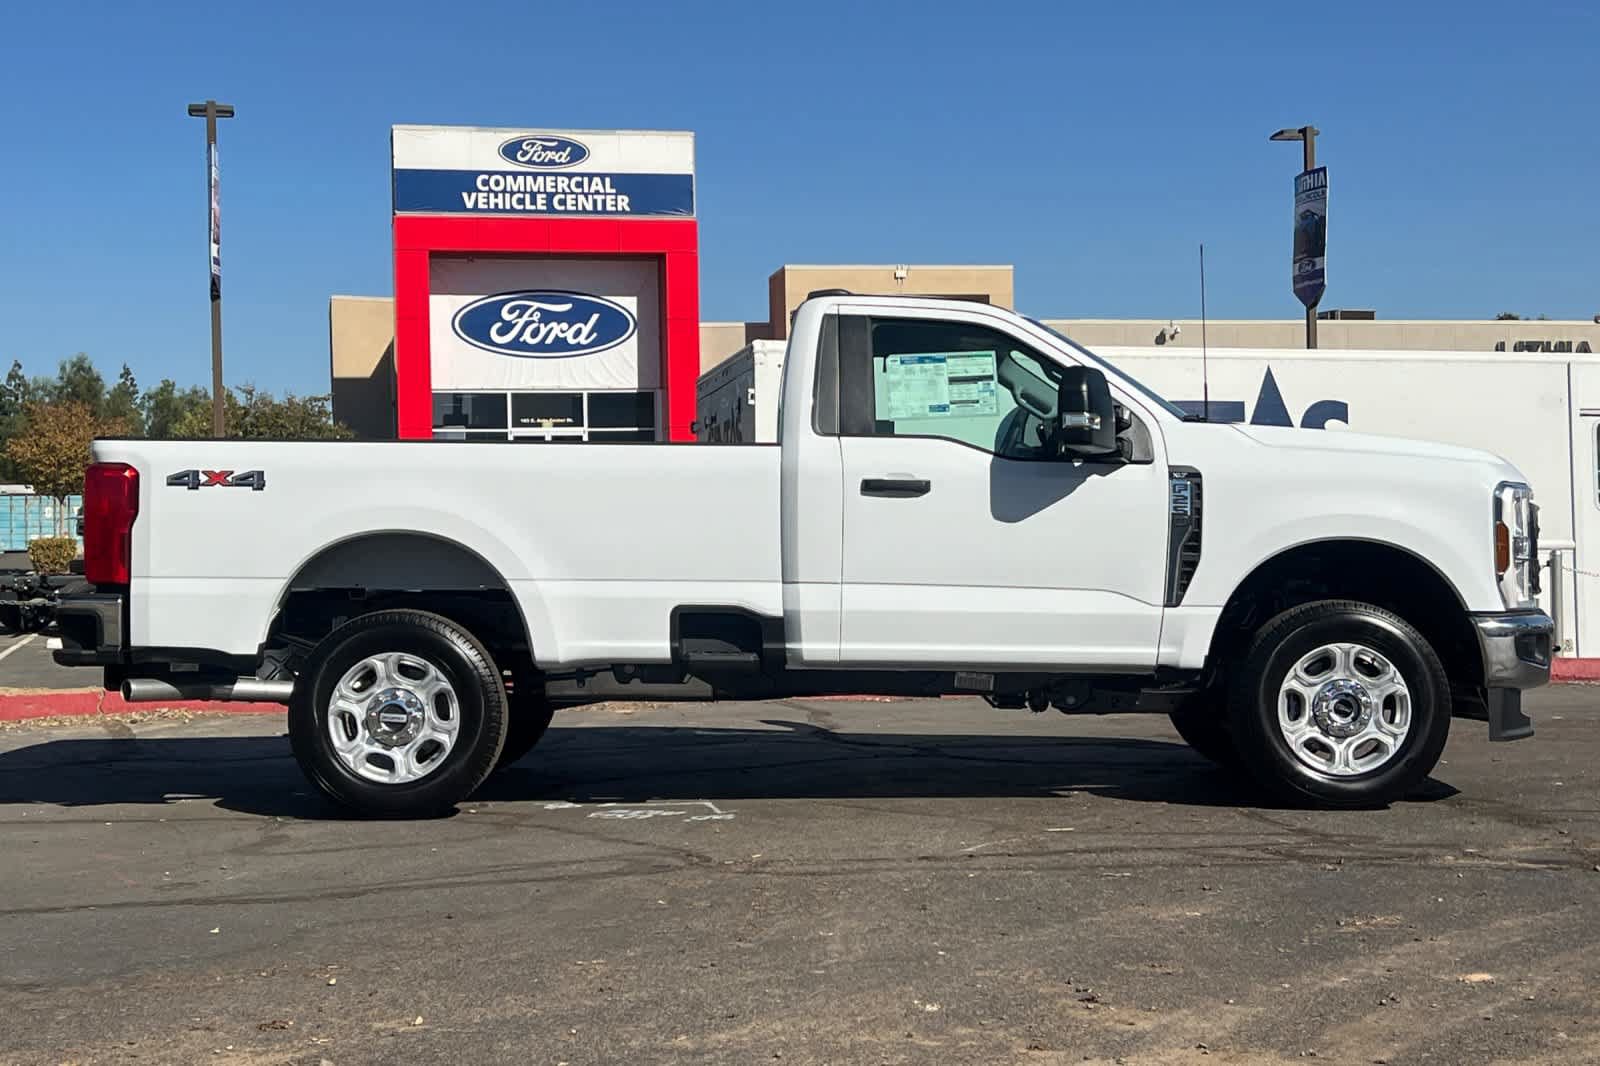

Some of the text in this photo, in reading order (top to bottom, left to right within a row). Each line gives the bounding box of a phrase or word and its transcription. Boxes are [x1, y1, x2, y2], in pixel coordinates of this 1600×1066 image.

[516, 138, 572, 165] Ford
[475, 174, 617, 194] COMMERCIAL
[461, 191, 631, 212] VEHICLE CENTER
[489, 300, 601, 345] Ford
